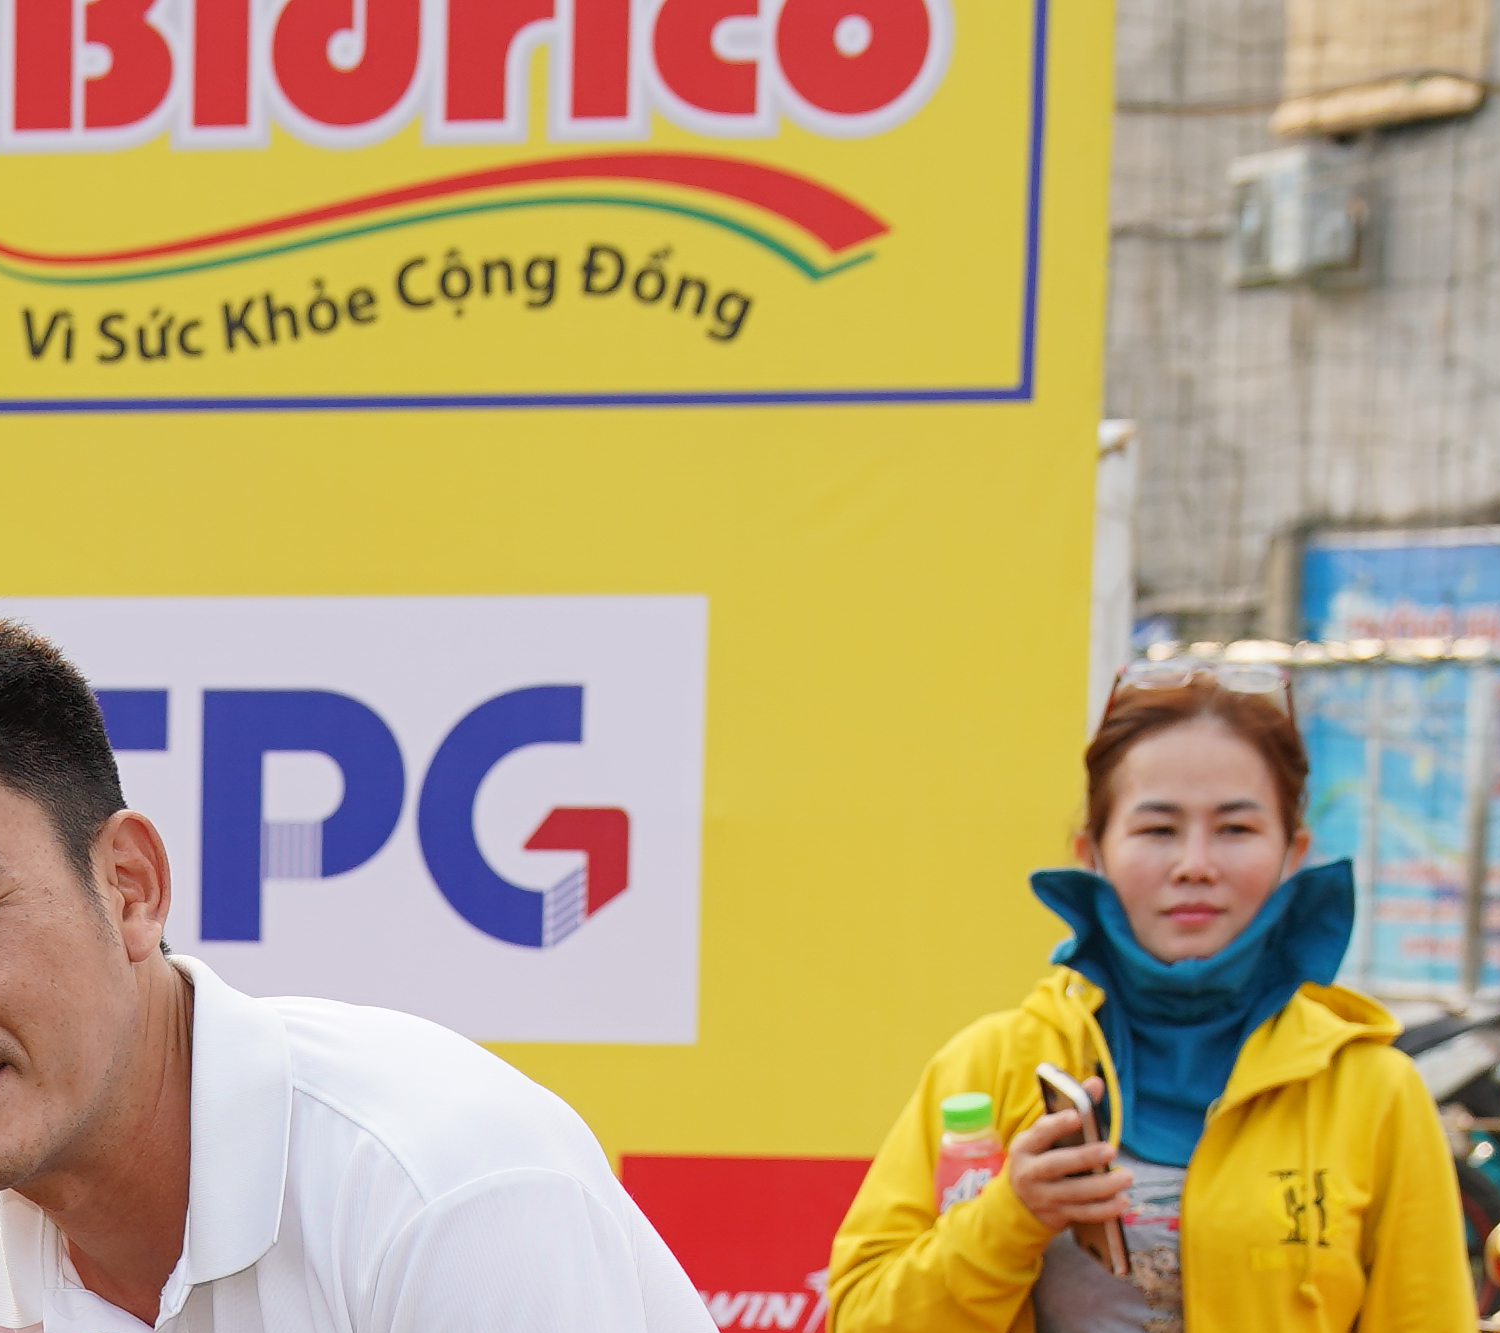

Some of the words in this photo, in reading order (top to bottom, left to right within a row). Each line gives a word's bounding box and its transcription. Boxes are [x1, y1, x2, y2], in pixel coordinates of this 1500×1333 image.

[20, 306, 76, 365] Vì
[95, 306, 205, 367] Sức
[221, 277, 379, 354] Khỏe
[394, 246, 559, 320] Cộng
[578, 242, 756, 345] Đồng
[95, 684, 629, 949] PG
